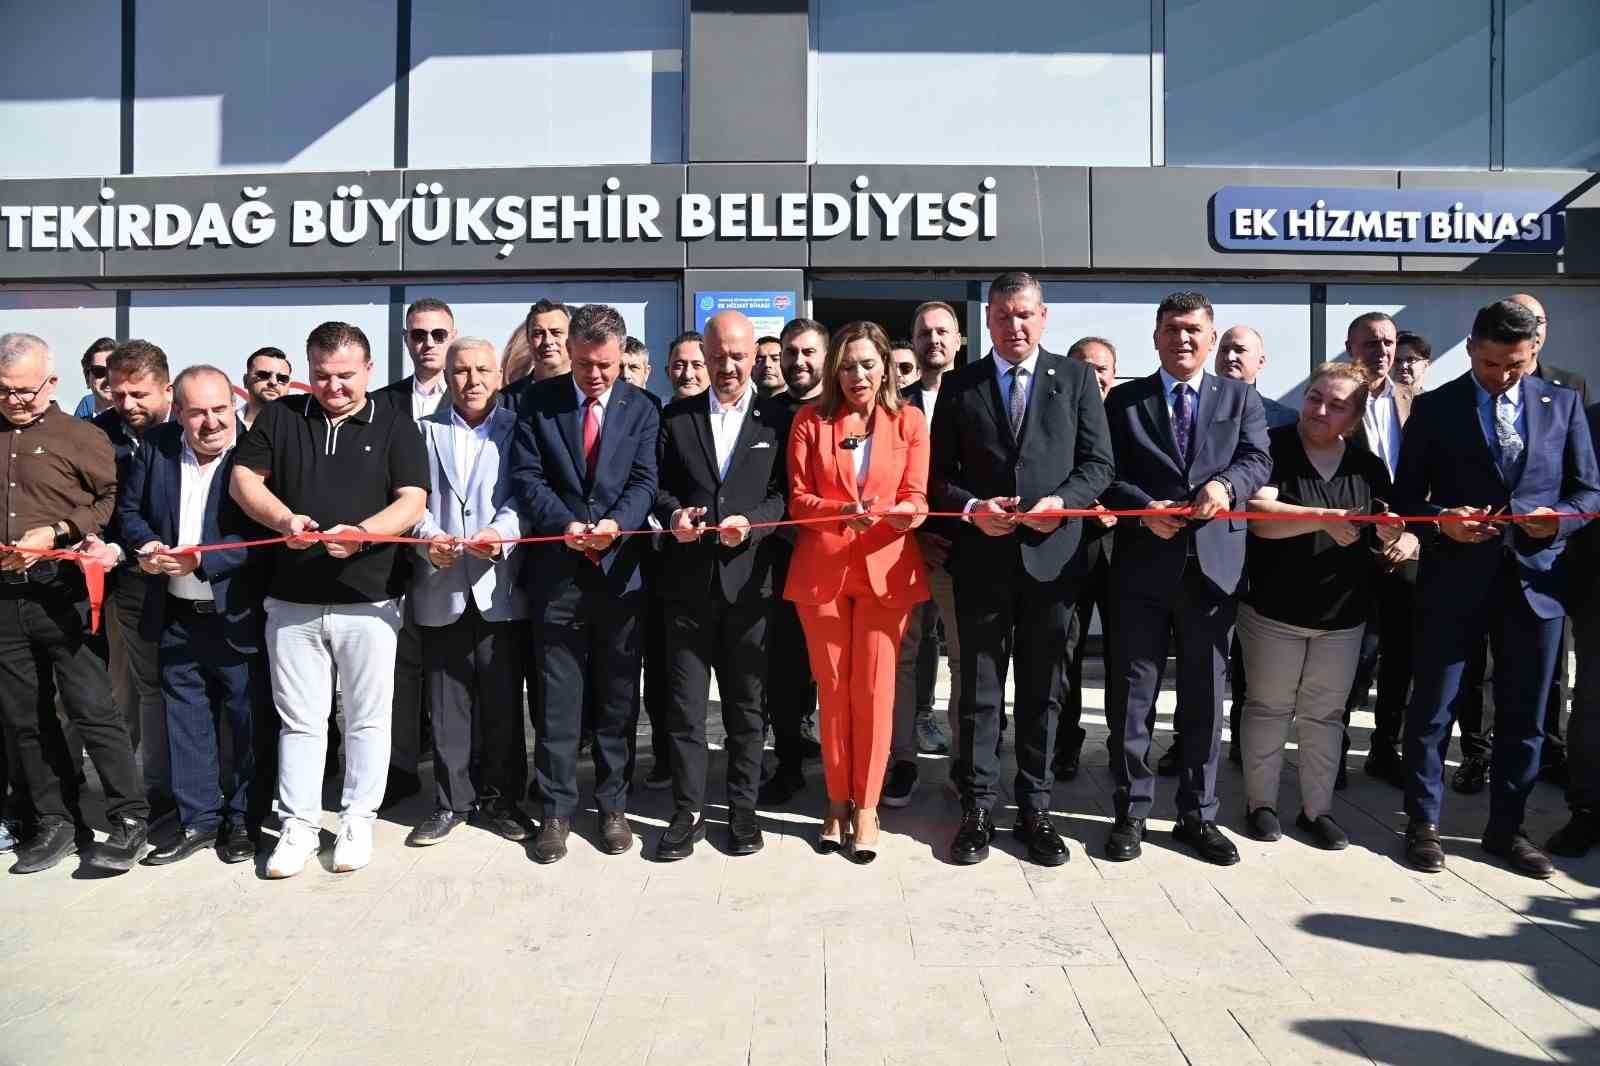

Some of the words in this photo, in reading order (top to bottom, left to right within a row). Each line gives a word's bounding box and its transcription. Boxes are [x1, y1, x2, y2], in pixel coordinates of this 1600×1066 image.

[1, 186, 277, 249] TEKİRDAĞ
[291, 177, 664, 257] BÜYÜKŞEHİR
[680, 175, 998, 239] BELEDİYESİ
[1234, 208, 1278, 238] EK
[1288, 199, 1421, 240] HİZMET
[1430, 201, 1552, 241] BİNASI
